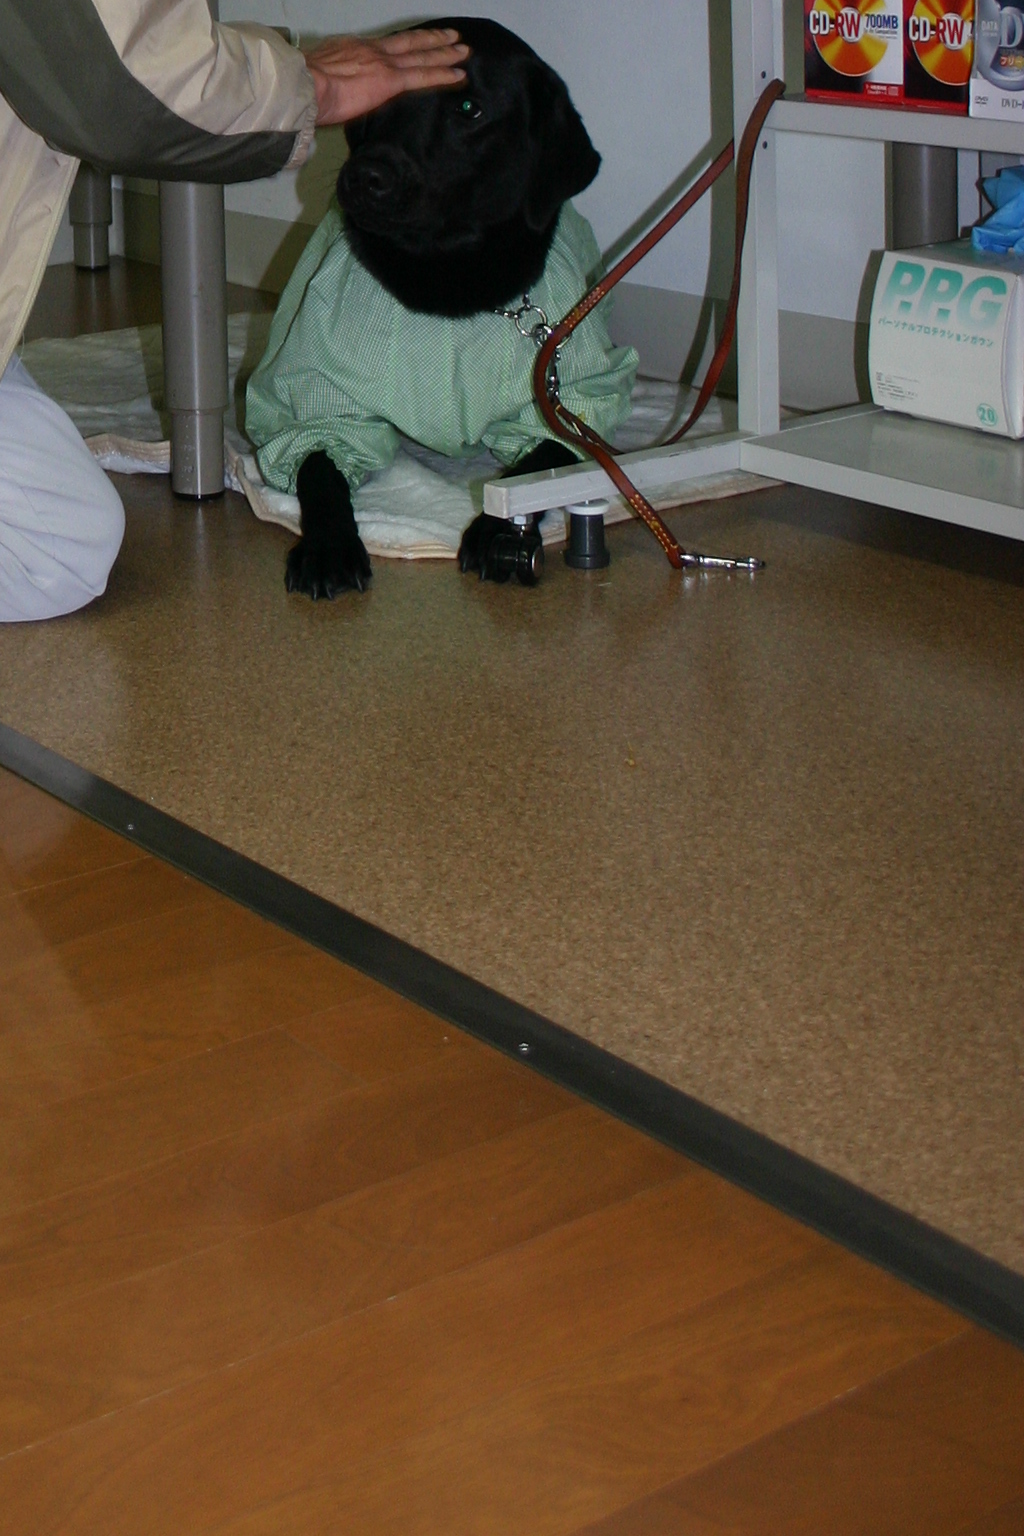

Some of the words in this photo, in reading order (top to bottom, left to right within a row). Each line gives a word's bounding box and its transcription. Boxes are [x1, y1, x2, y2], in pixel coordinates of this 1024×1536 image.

[809, 9, 861, 38] CD-RW
[864, 13, 899, 30] 700MB
[908, 14, 965, 45] CD-RW
